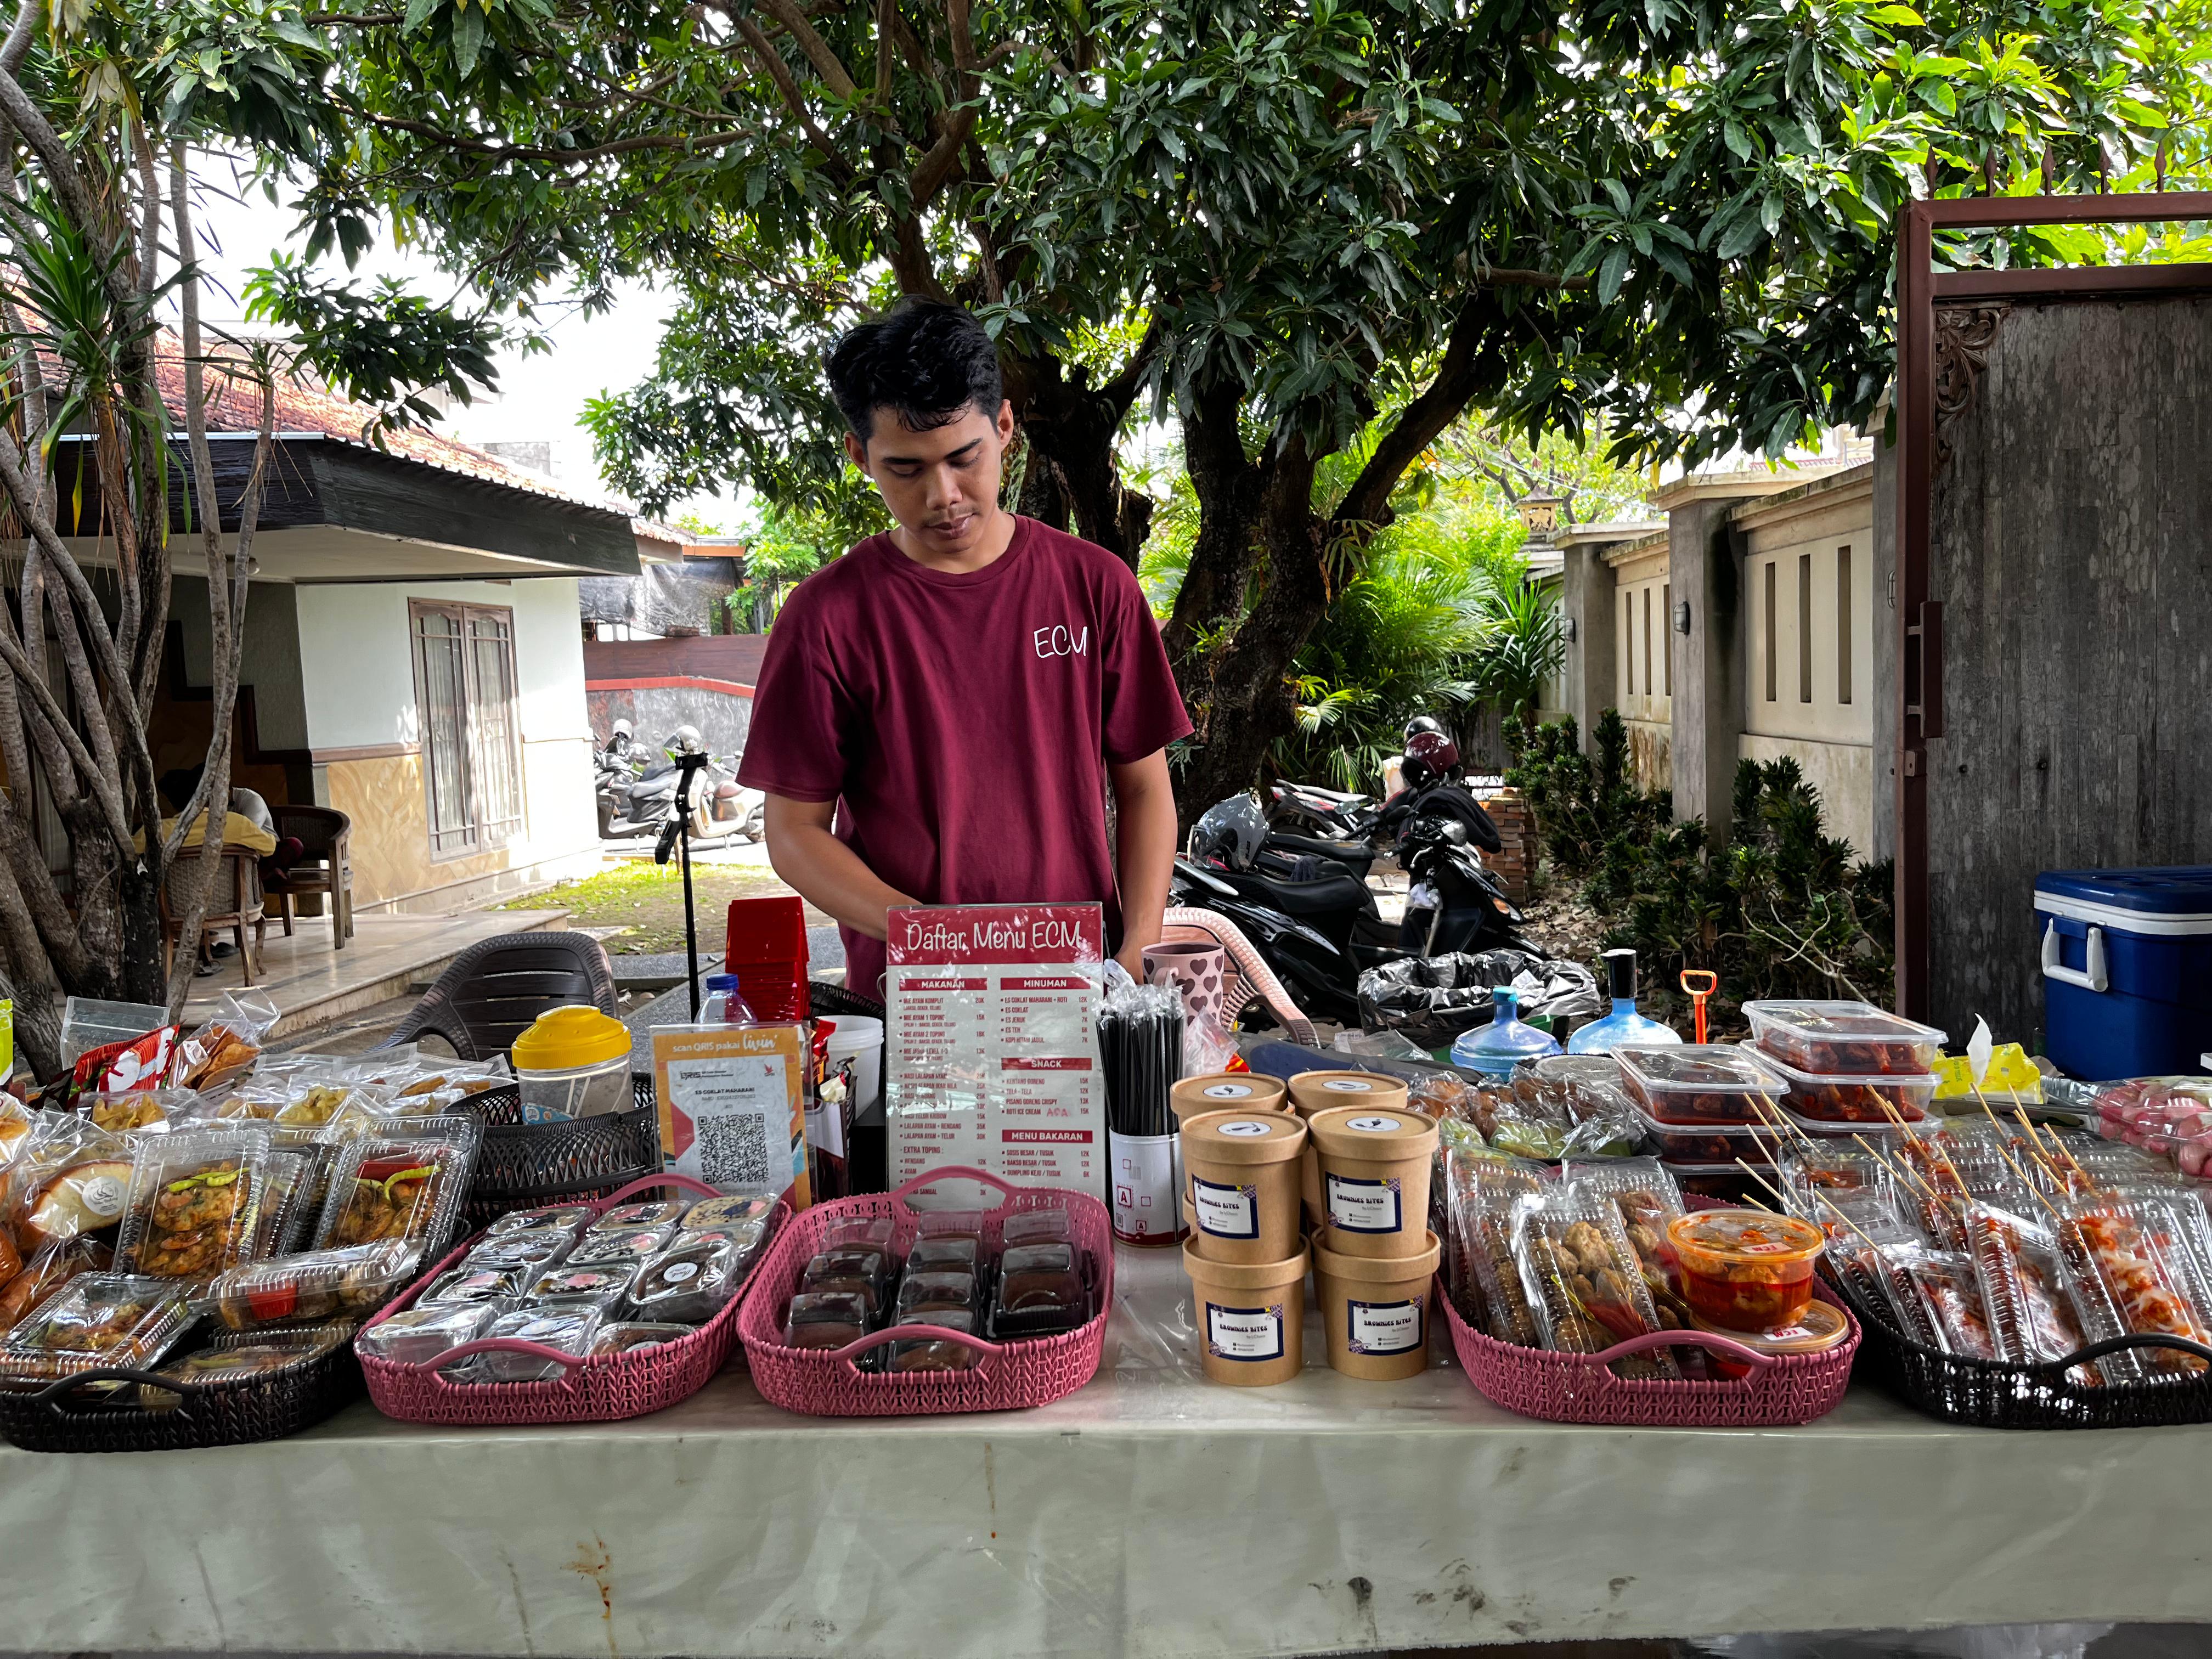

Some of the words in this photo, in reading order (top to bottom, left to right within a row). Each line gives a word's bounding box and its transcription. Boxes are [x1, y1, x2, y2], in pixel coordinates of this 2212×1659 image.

[907, 923, 966, 951] Daftar
[974, 922, 1025, 949] Menu
[1032, 921, 1081, 949] ECM
[693, 1043, 714, 1052] QRIS
[716, 1041, 740, 1051] pakai
[1039, 1132, 1083, 1141] BAKARAN
[1121, 1190, 1127, 1203] A
